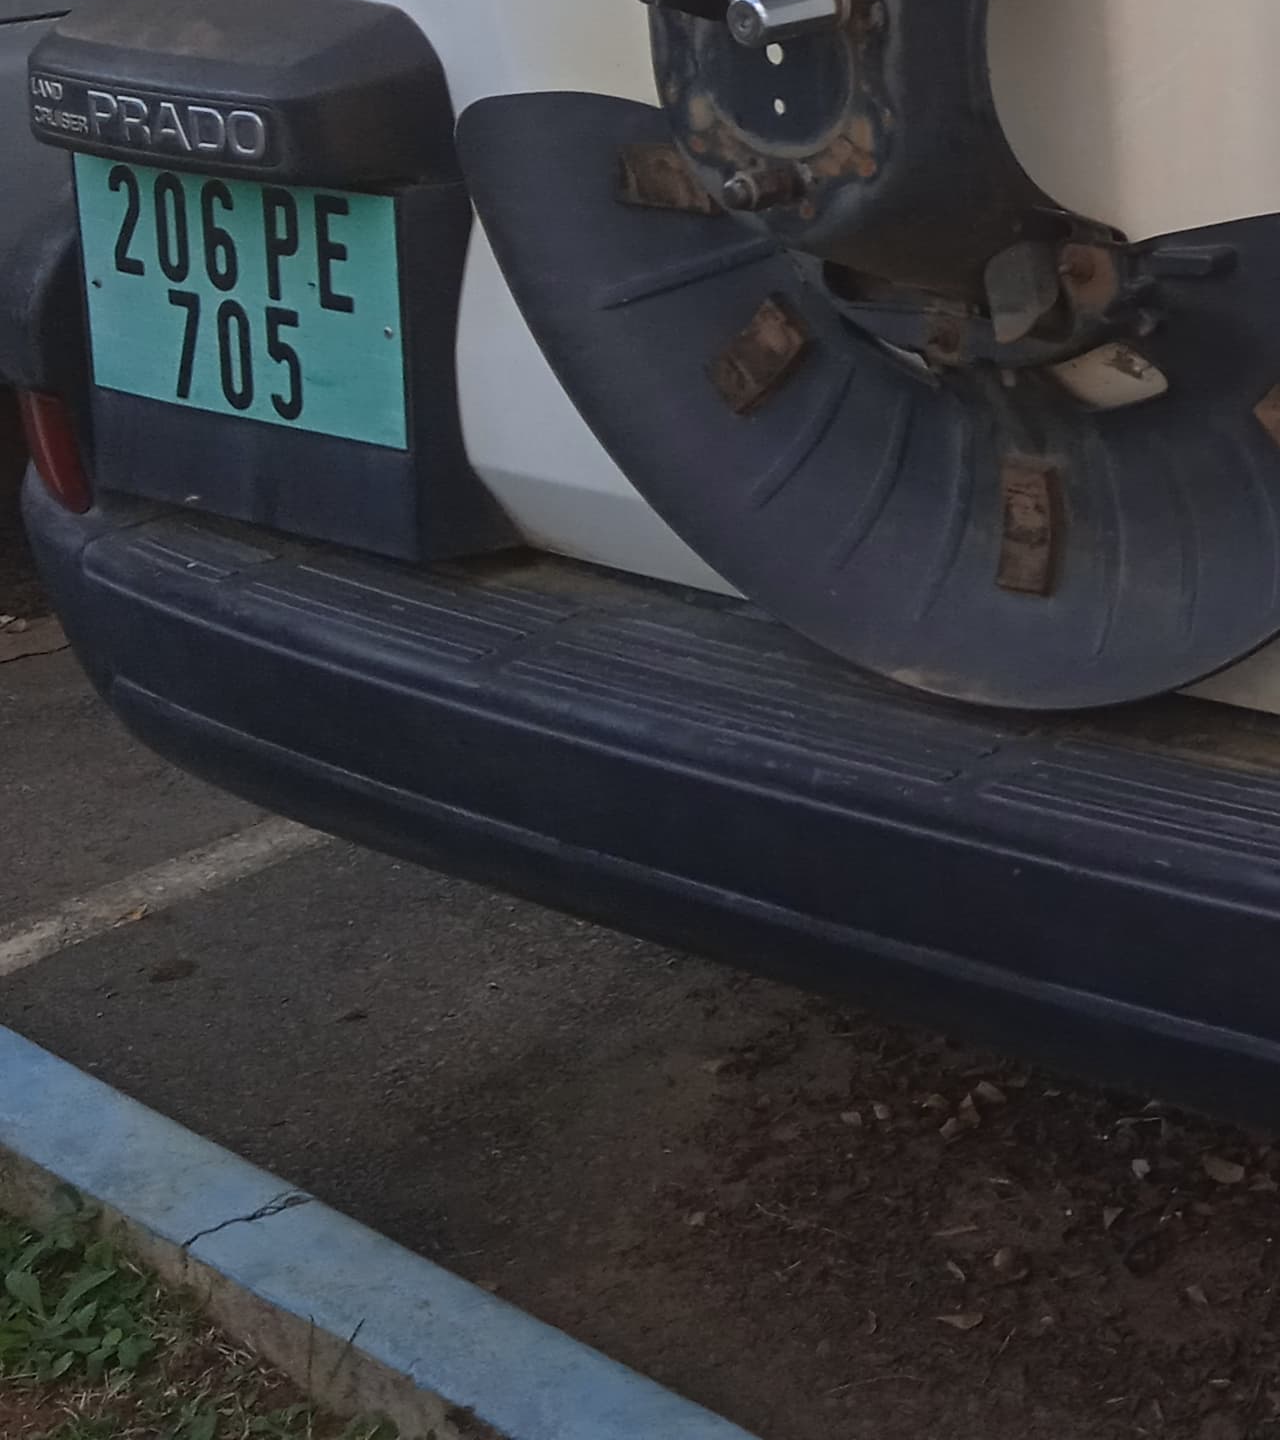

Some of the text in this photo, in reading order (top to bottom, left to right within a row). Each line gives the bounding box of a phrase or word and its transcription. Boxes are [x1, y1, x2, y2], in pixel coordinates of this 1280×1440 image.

[31, 76, 63, 100] LAND
[34, 105, 89, 134] CRUISER
[88, 90, 266, 156] PRADO
[168, 289, 303, 421] 705
